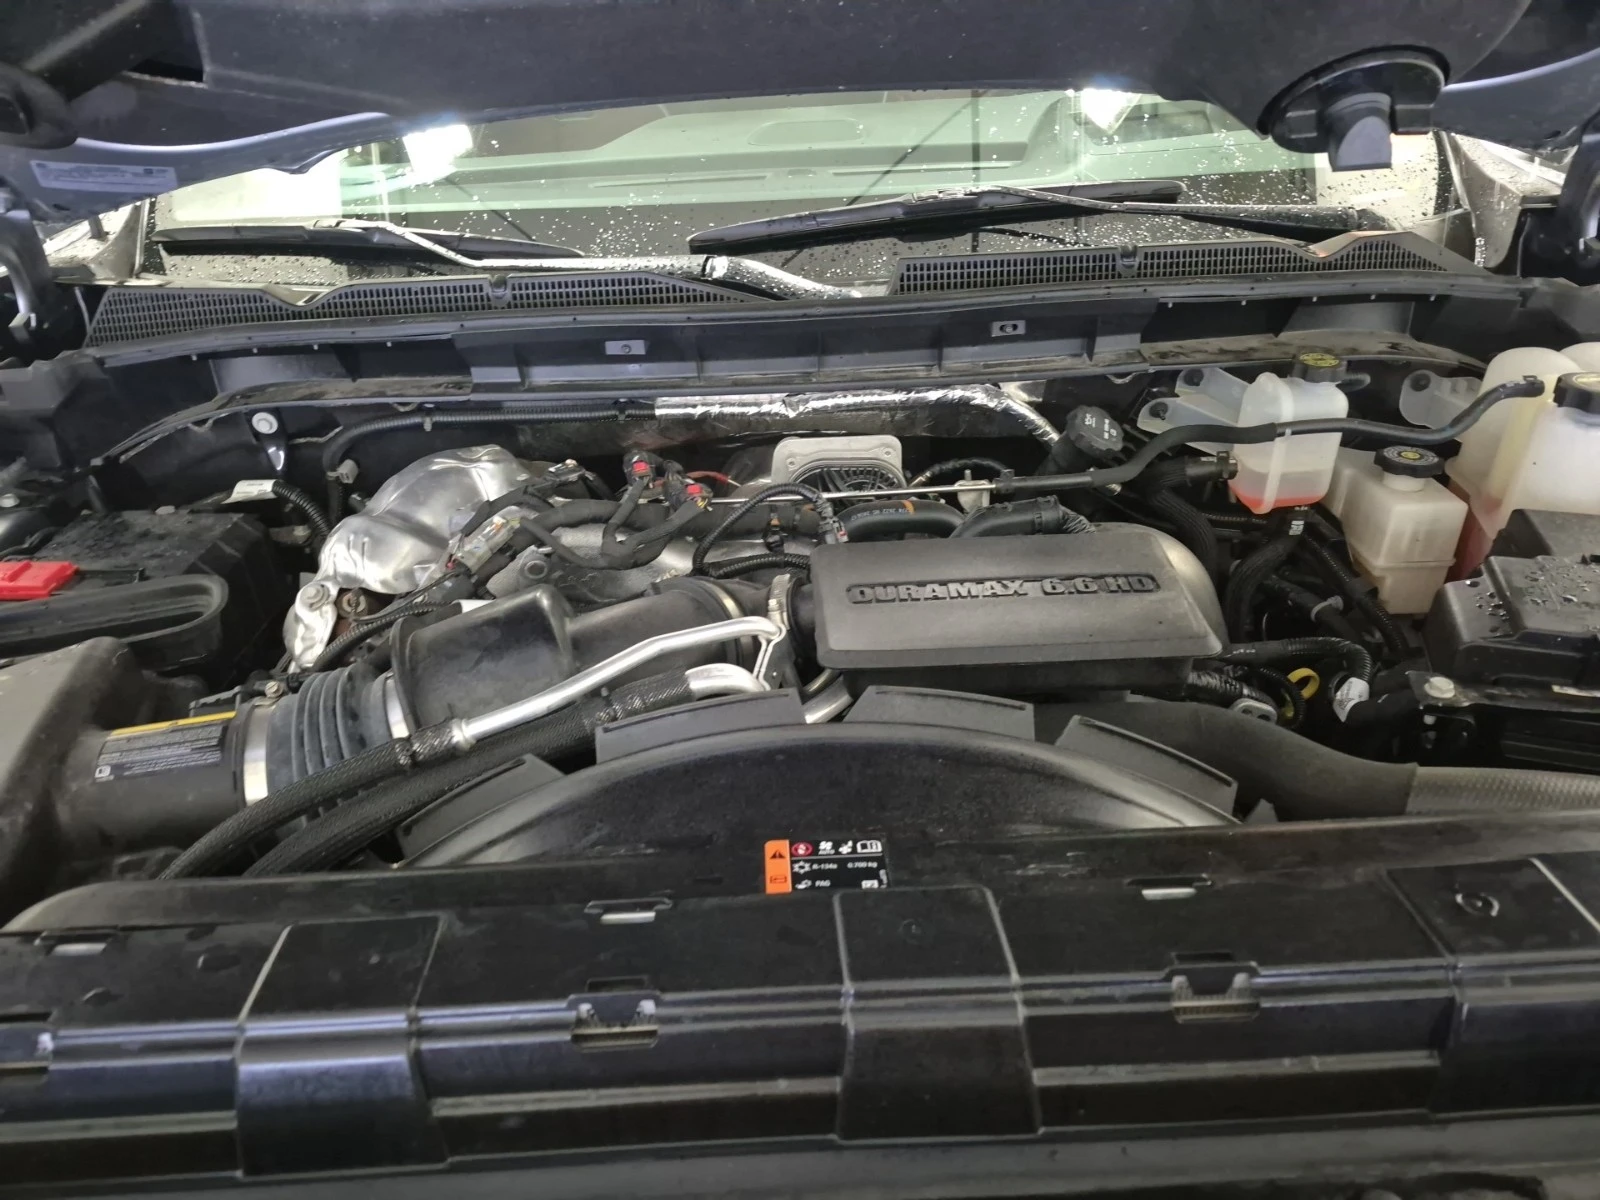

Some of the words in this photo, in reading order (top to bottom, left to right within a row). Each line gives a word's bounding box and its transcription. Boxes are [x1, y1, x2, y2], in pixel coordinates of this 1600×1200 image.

[850, 580, 1027, 603] DURAMAX
[1042, 577, 1098, 595] 6.6
[1104, 575, 1156, 593] HD
